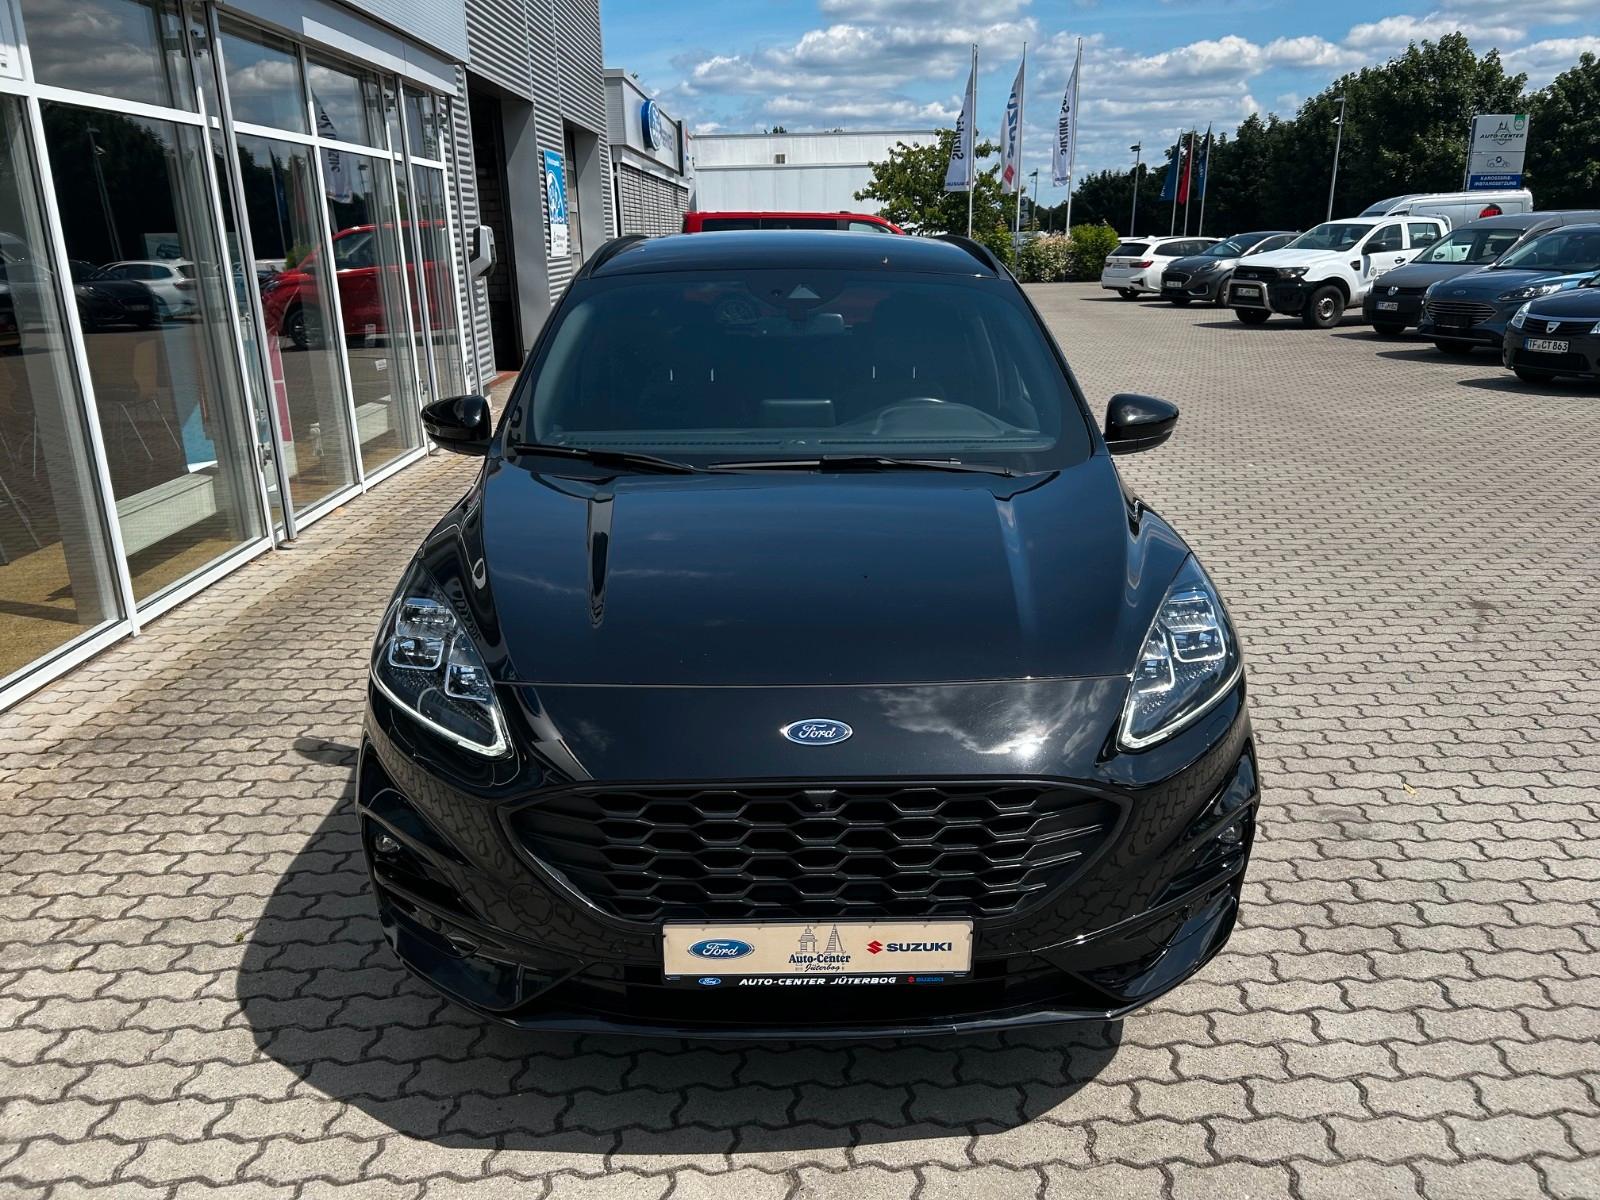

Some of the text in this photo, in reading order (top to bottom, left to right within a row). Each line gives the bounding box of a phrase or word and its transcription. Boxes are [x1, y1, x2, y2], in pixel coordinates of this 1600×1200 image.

[798, 724, 836, 738] Ford
[702, 942, 739, 956] Ford
[886, 942, 952, 952] SUZUKI
[788, 953, 851, 964] Auto-Center
[804, 963, 841, 972] Jüterbog
[739, 975, 897, 986] AUTO-CENTER JÜTERBOG
